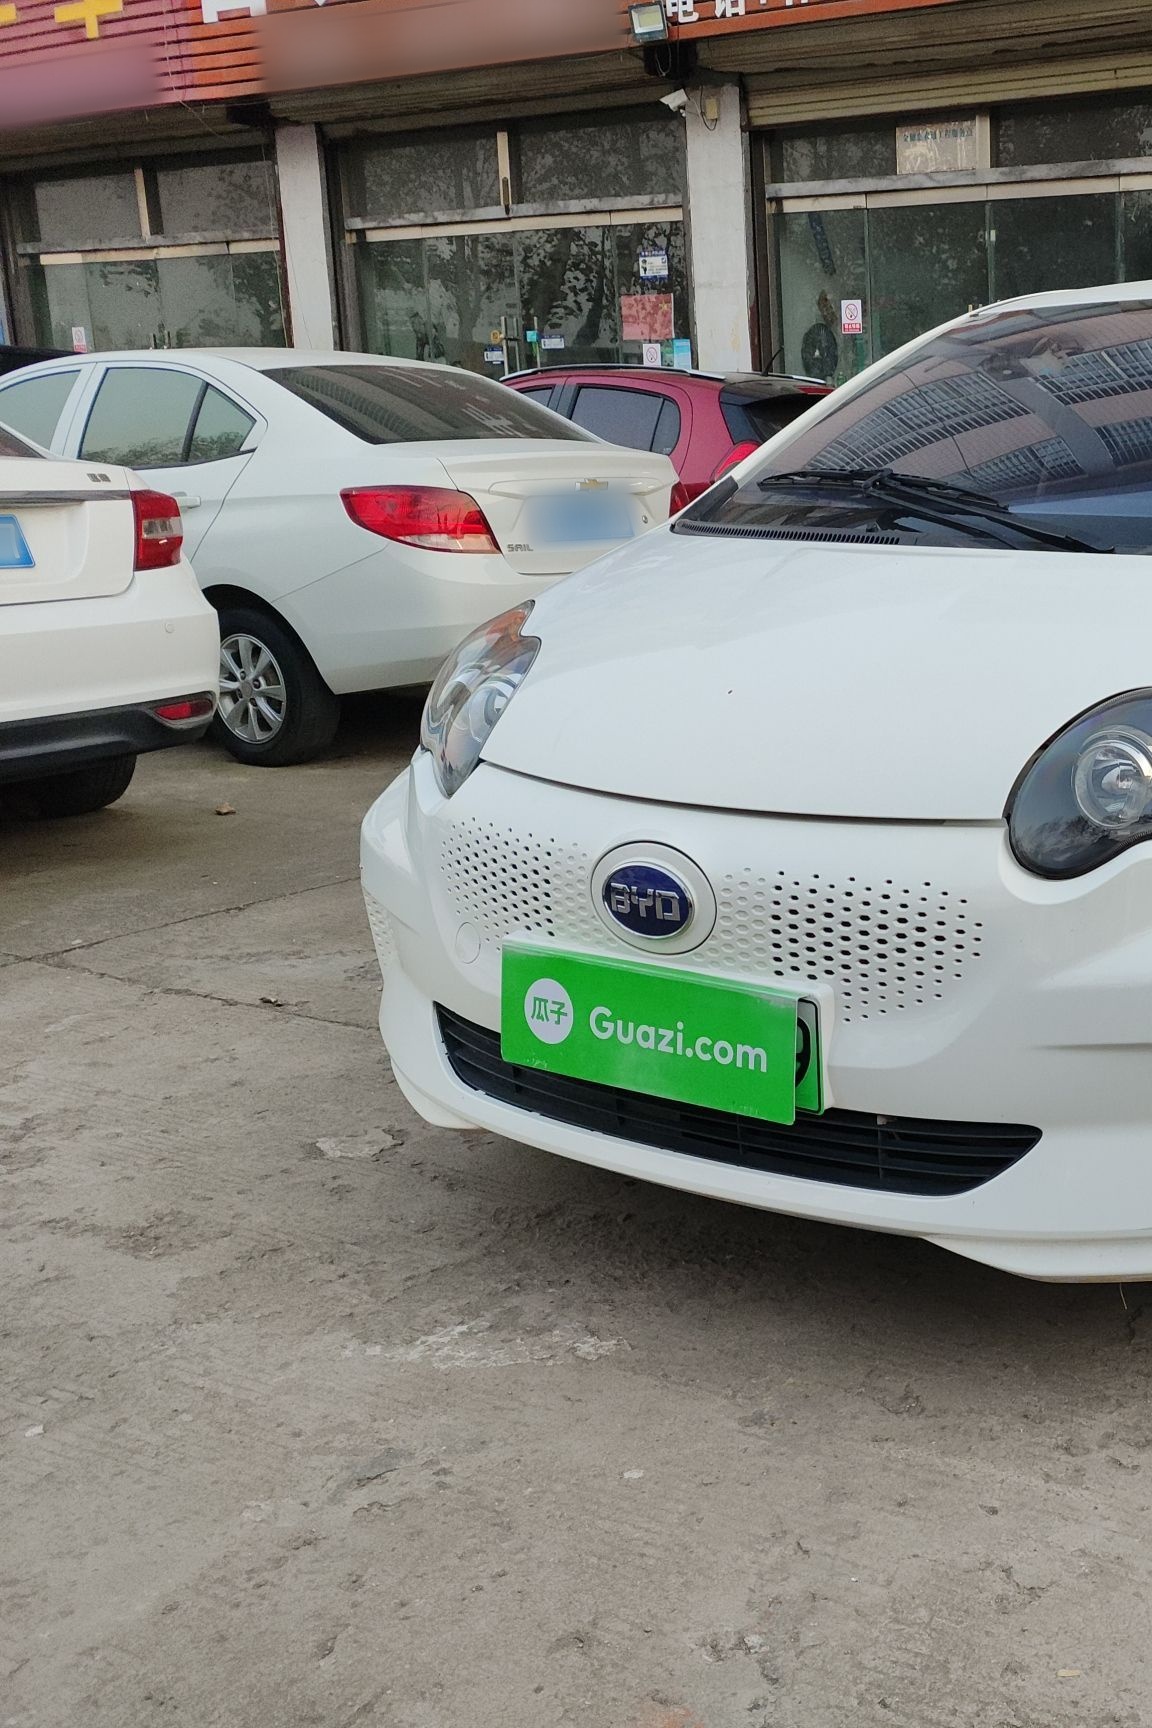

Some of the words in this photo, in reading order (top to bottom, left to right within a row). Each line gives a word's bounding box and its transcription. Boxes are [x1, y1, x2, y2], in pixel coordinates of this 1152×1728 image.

[507, 543, 534, 552] SAIL
[610, 882, 681, 922] BYD
[530, 996, 568, 1025] 瓜子
[589, 1006, 767, 1073] Guazi.com
